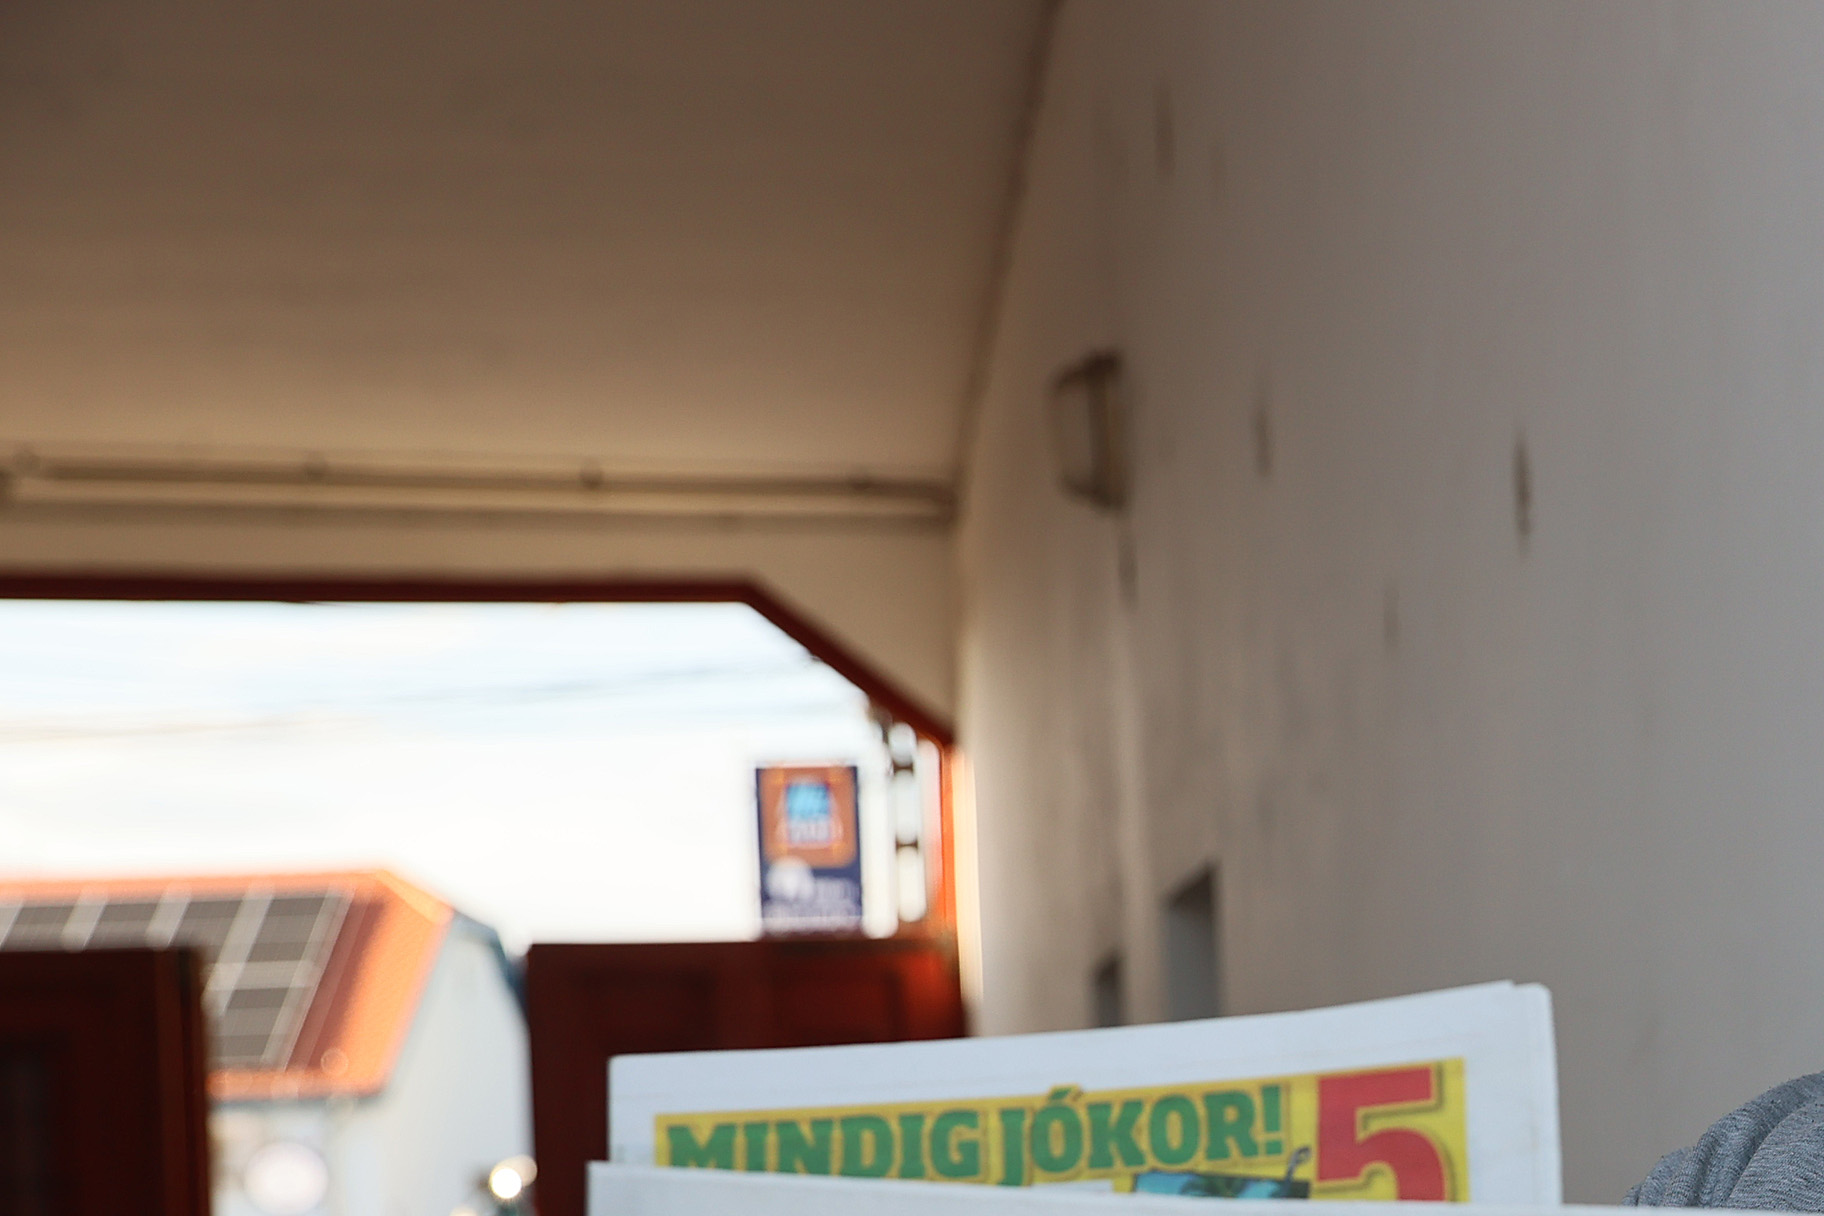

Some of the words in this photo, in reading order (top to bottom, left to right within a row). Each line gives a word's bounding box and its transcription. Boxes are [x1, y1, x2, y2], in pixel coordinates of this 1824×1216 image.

[667, 1109, 981, 1180] MINDIG
[998, 1084, 1283, 1187] JÓKOR!
[1316, 1066, 1447, 1201] 5
